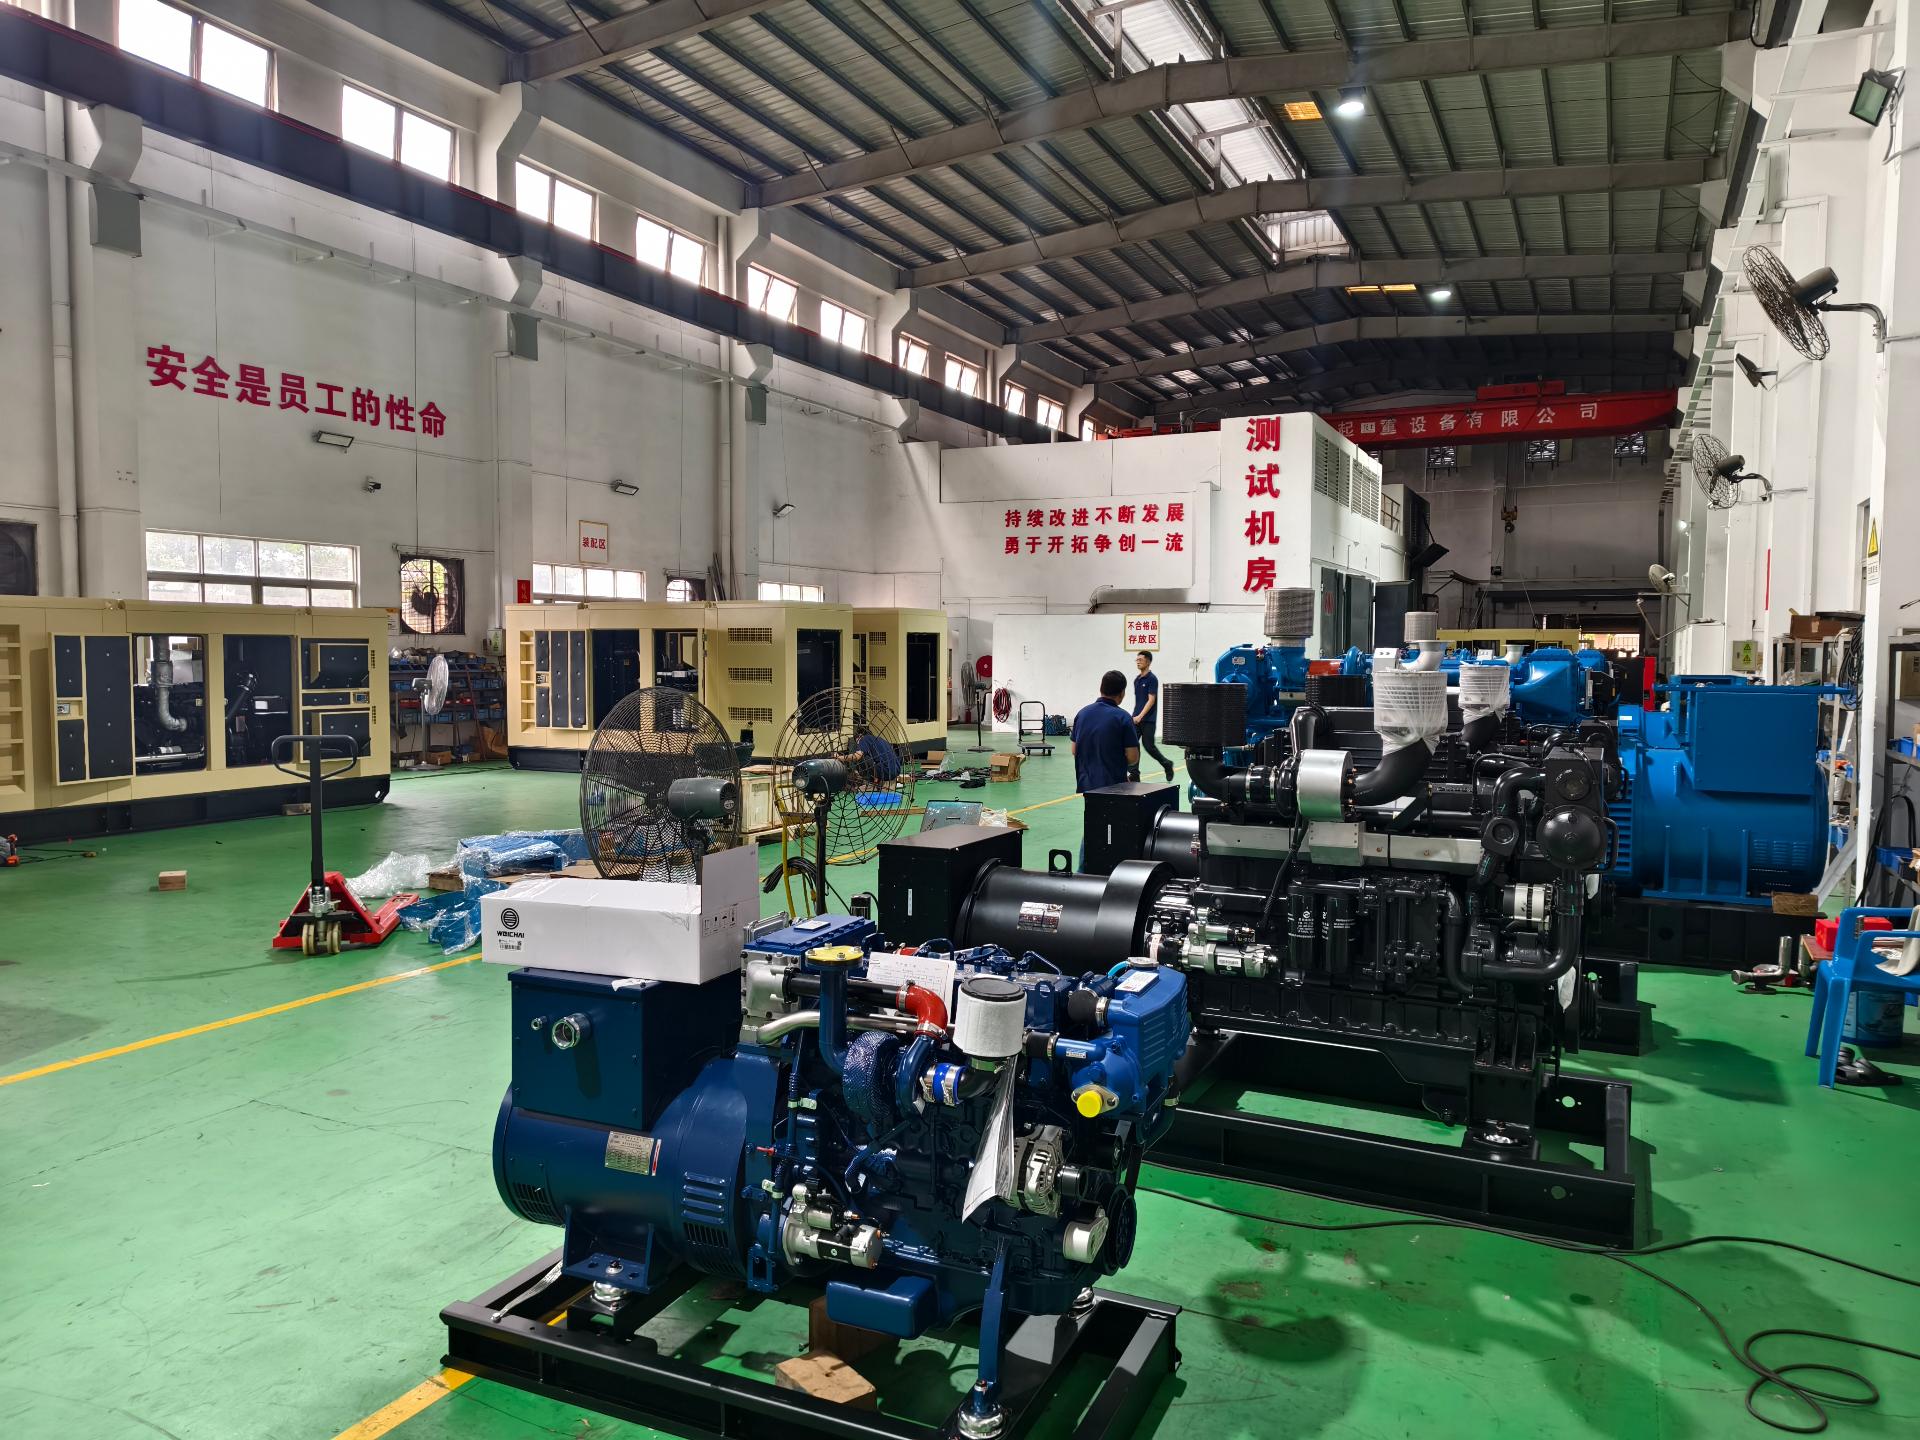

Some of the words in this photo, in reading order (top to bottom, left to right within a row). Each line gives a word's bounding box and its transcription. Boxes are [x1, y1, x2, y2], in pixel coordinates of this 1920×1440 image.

[146, 344, 447, 438] 安全是员工的性命
[1243, 416, 1281, 592] 测试机房
[1004, 502, 1185, 528] 持续改进不断发展
[582, 536, 607, 550] 装配区
[1004, 532, 1184, 555] 勇于开拓争创一流
[1127, 620, 1158, 631] 不合格品
[1128, 634, 1157, 645] 存放区
[497, 930, 525, 939] WEICHAI
